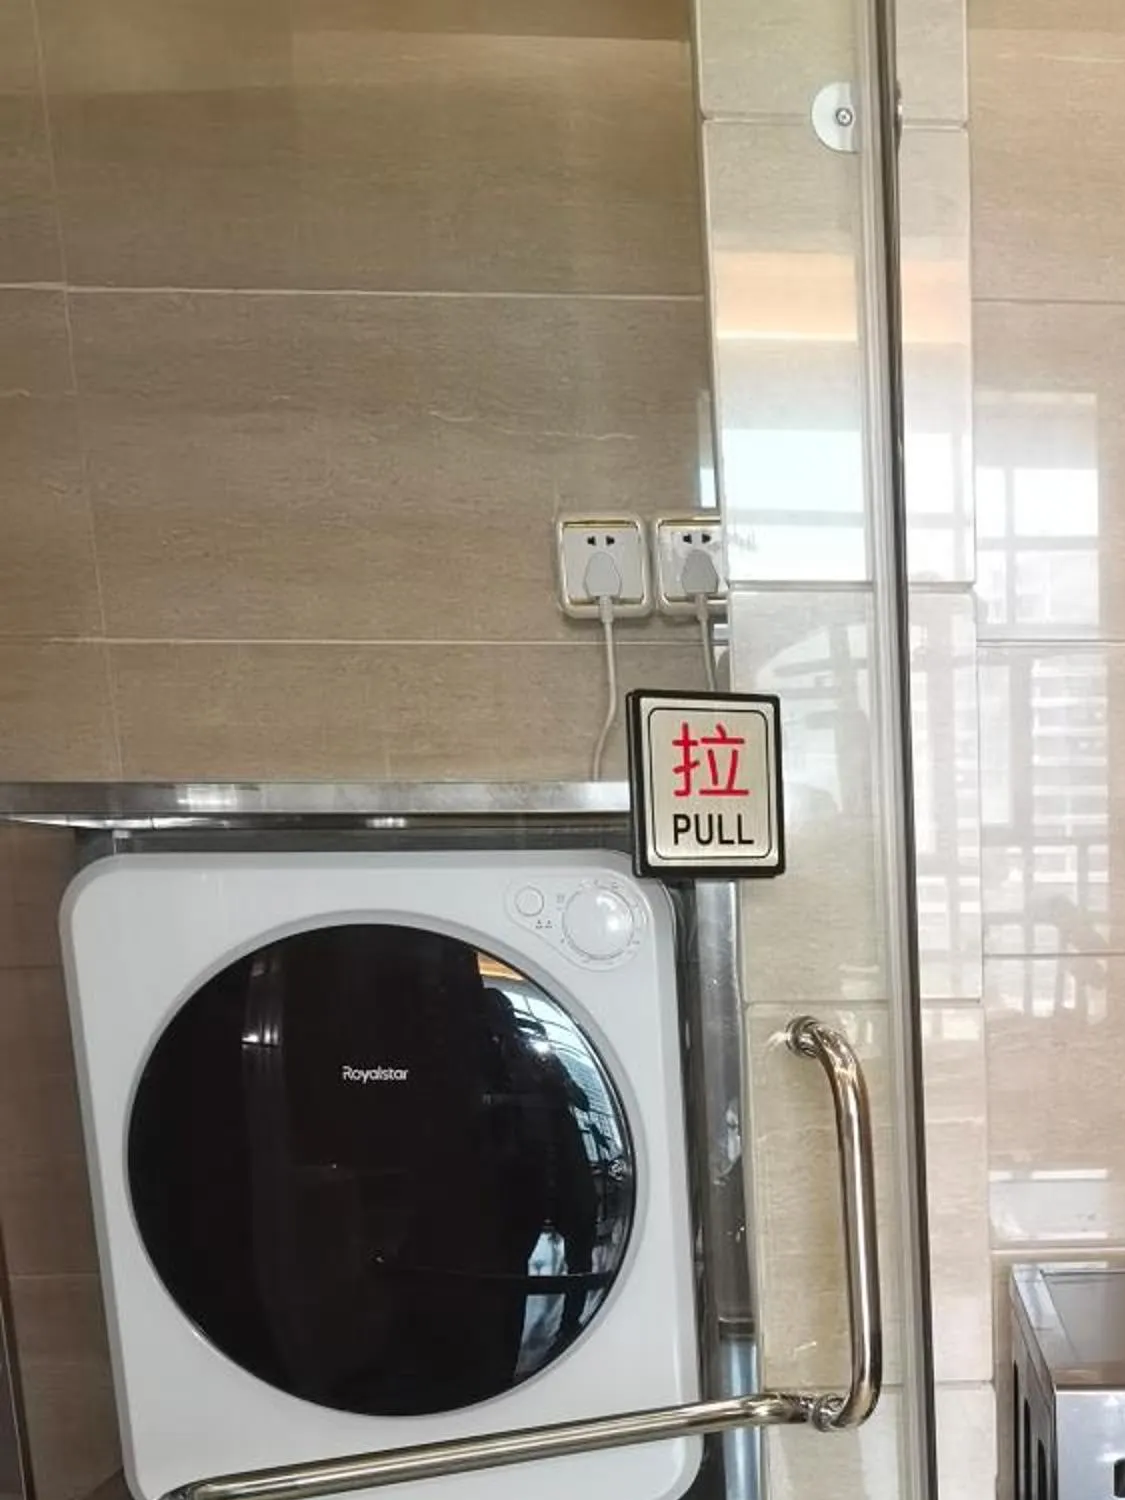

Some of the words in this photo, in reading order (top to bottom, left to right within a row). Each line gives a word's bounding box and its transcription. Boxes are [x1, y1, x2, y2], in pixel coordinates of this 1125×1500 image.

[672, 721, 750, 797] 拉
[672, 813, 754, 846] PULL
[341, 1065, 409, 1085] Royalstar
